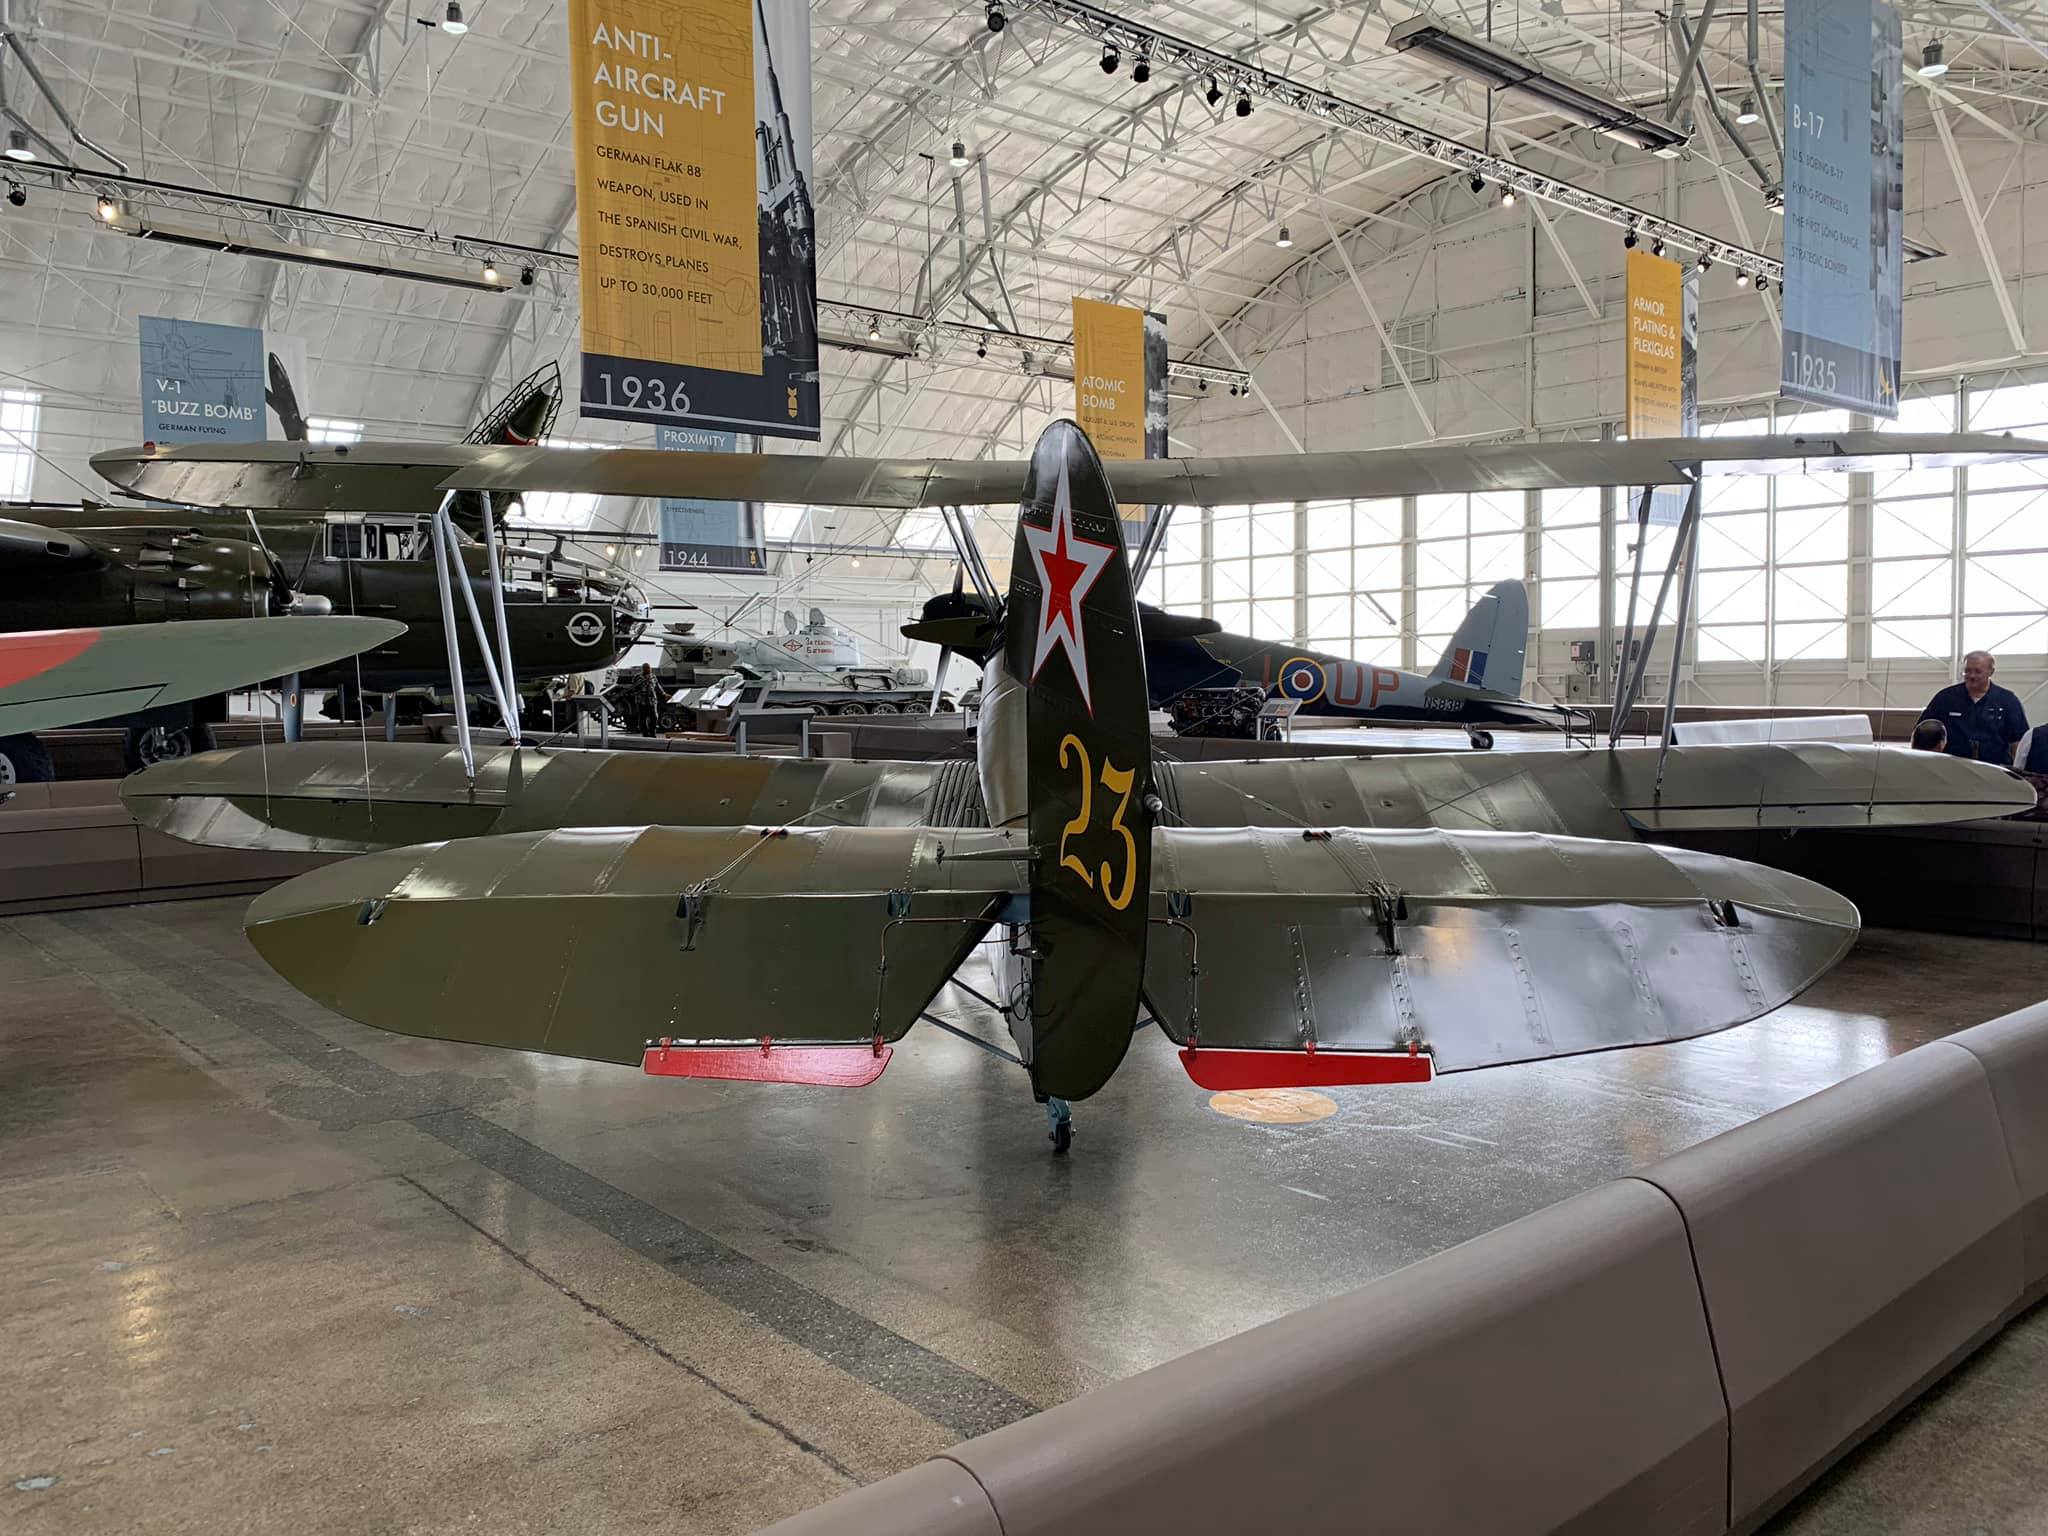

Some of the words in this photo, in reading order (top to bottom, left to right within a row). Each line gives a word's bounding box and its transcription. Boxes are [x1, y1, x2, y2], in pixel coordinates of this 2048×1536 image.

[592, 22, 672, 61] ANTI-
[593, 62, 726, 115] AIRCRAFT
[595, 101, 664, 138] GUN
[1793, 104, 1825, 139] B-17
[596, 145, 650, 166] GERMAN
[654, 157, 683, 174] FLAK
[687, 165, 702, 178] 88
[597, 178, 656, 201] WEAPON,
[660, 192, 691, 206] USED
[696, 197, 709, 210] IN
[598, 211, 621, 226] THE
[626, 216, 677, 236] SPANISH
[681, 227, 710, 243] CIVIL
[713, 233, 743, 250] WAR,
[599, 244, 661, 265] DESTROYS
[665, 256, 709, 273] PLANES
[600, 277, 616, 289] UP
[620, 280, 638, 292] TO
[642, 284, 684, 301] 30,000
[688, 291, 713, 305] FEET
[1633, 296, 1665, 317] ARMOR
[1633, 316, 1668, 338] PLATING
[1669, 326, 1676, 340] &
[1633, 336, 1675, 360] PLEXIGLAS
[156, 378, 182, 394] V-1
[1081, 375, 1126, 393] ATOMIC
[1792, 351, 1836, 393] 1935
[600, 373, 691, 415] 1936
[1082, 395, 1115, 410] BOMB
[158, 423, 197, 433] GERMAN
[199, 426, 227, 435] FLYING
[664, 430, 726, 447] PROXIMITY
[668, 551, 709, 568] 1944
[1059, 733, 1137, 911] 23
